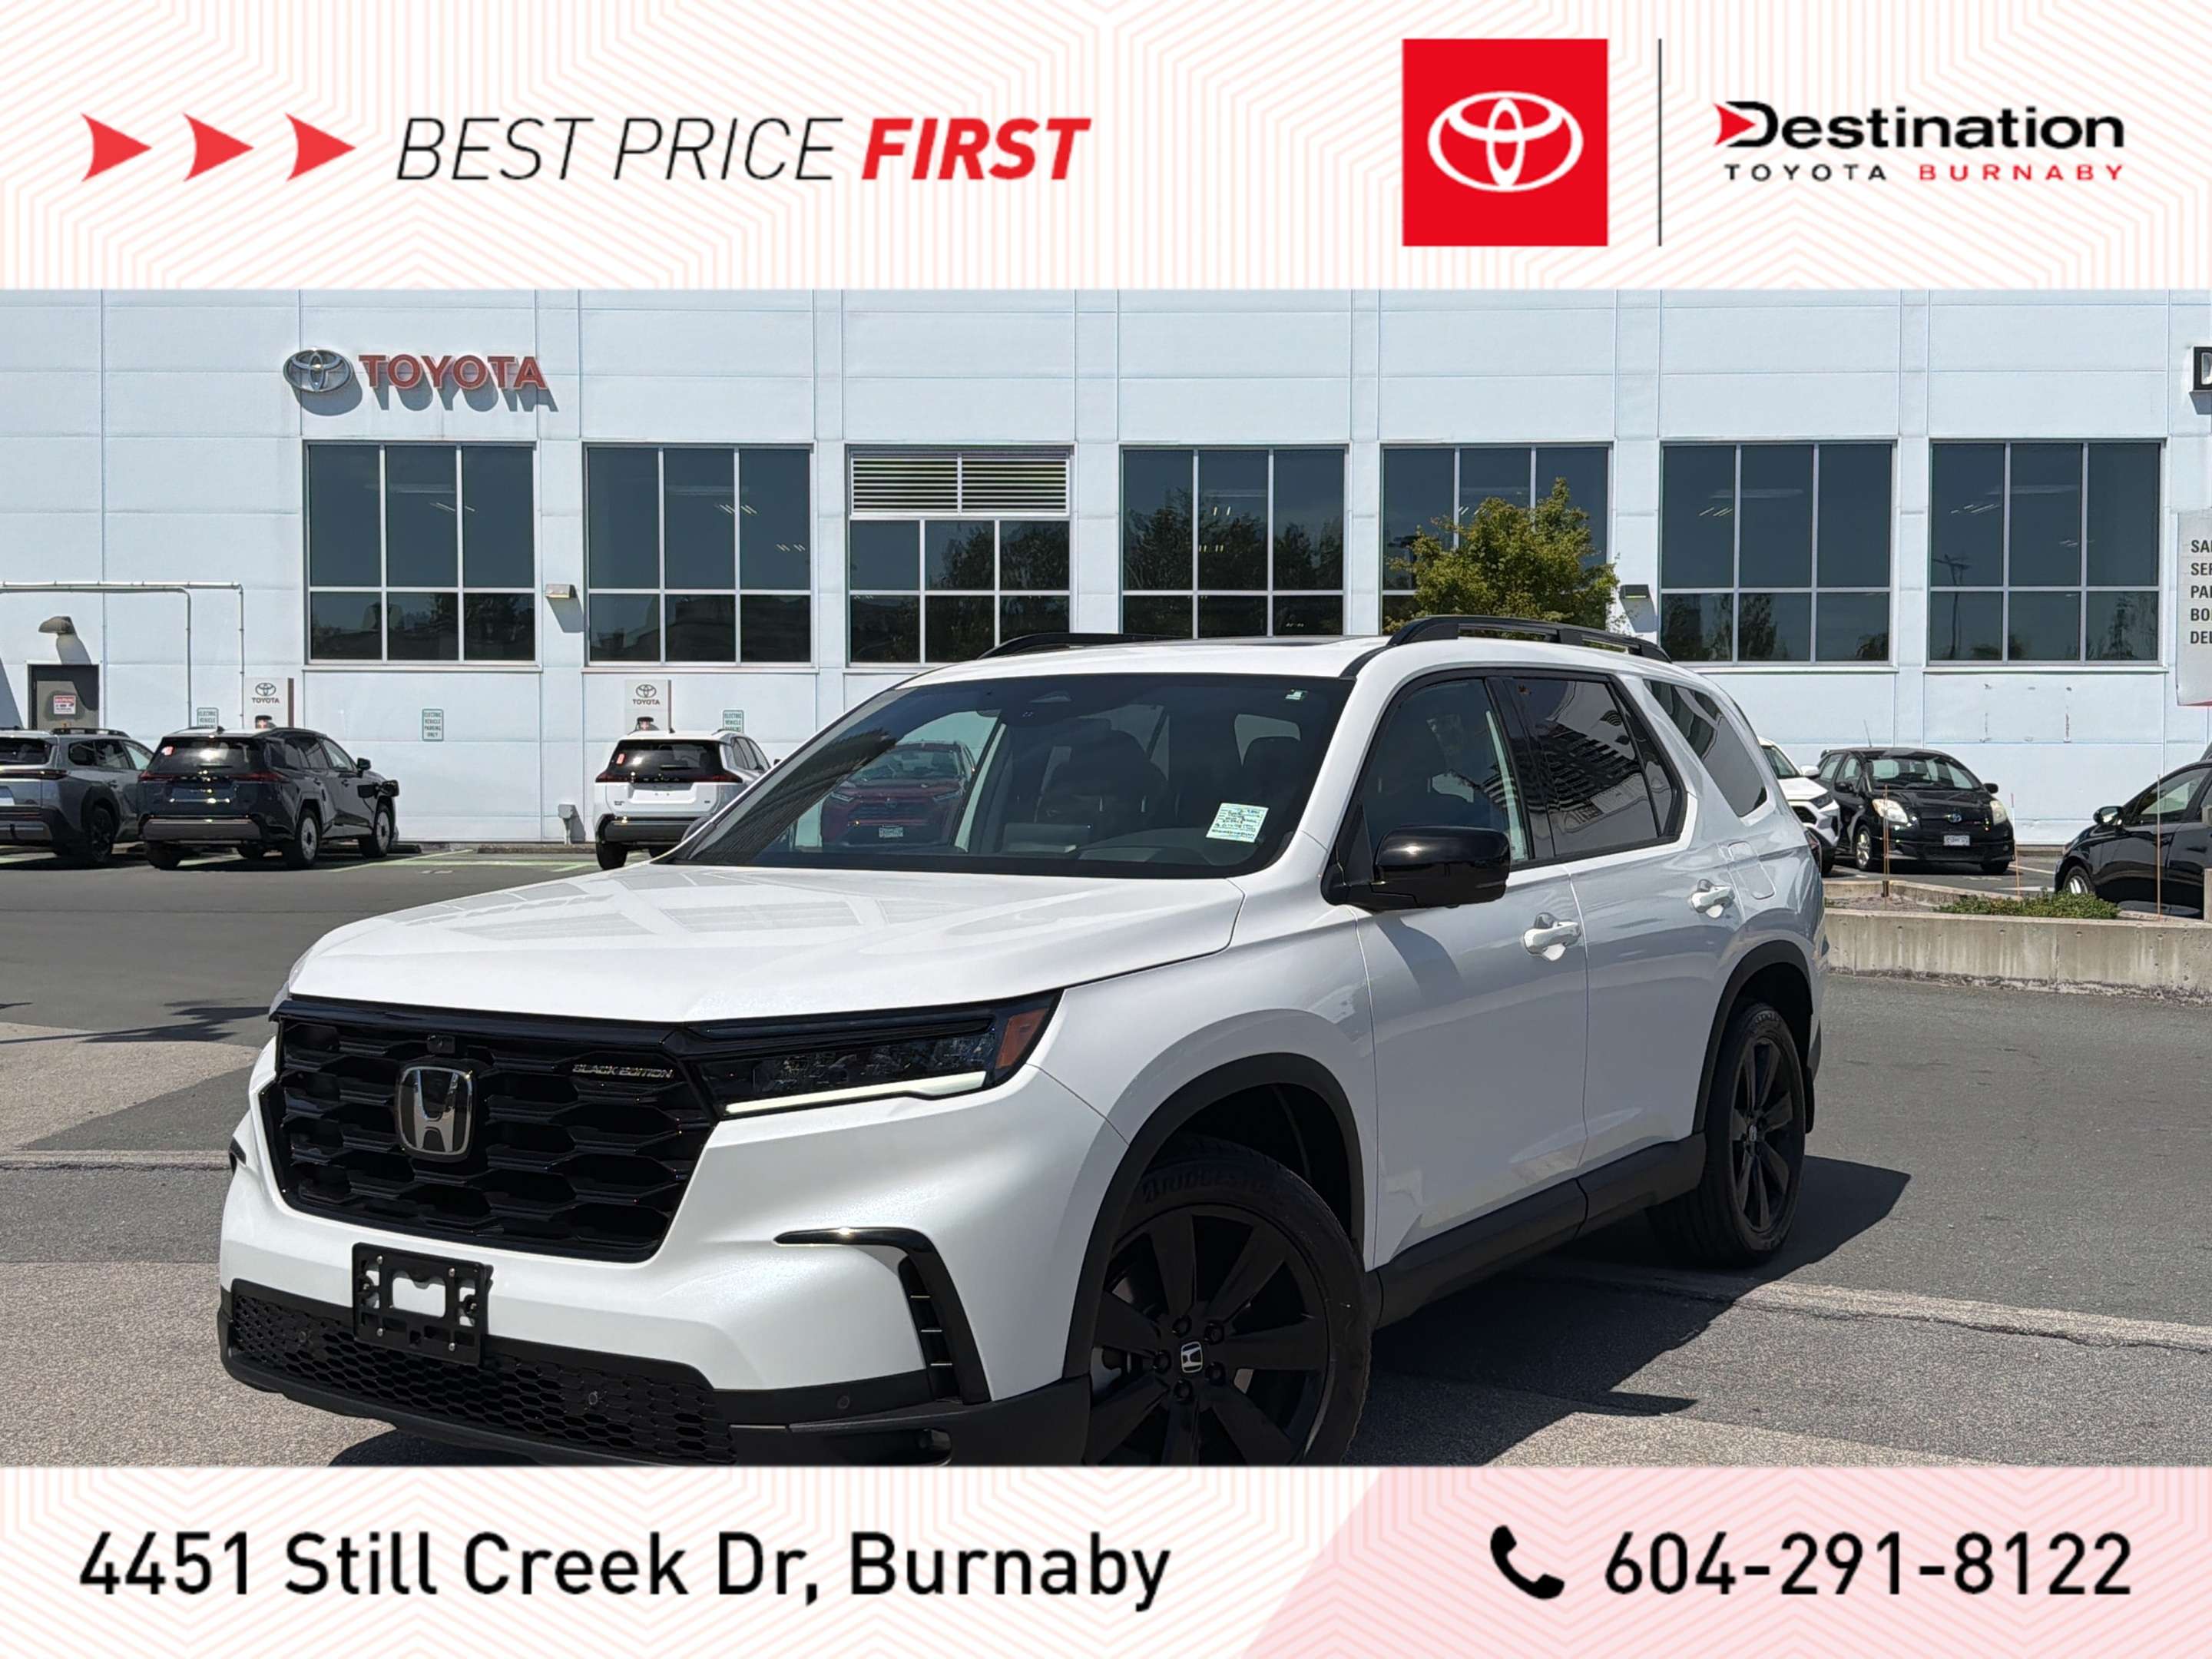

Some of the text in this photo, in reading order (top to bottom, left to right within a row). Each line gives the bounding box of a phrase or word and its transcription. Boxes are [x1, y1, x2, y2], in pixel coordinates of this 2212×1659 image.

[359, 354, 548, 390] TOYOTA
[2190, 608, 2212, 621] BO
[572, 1064, 674, 1079] BLACK EDITION
